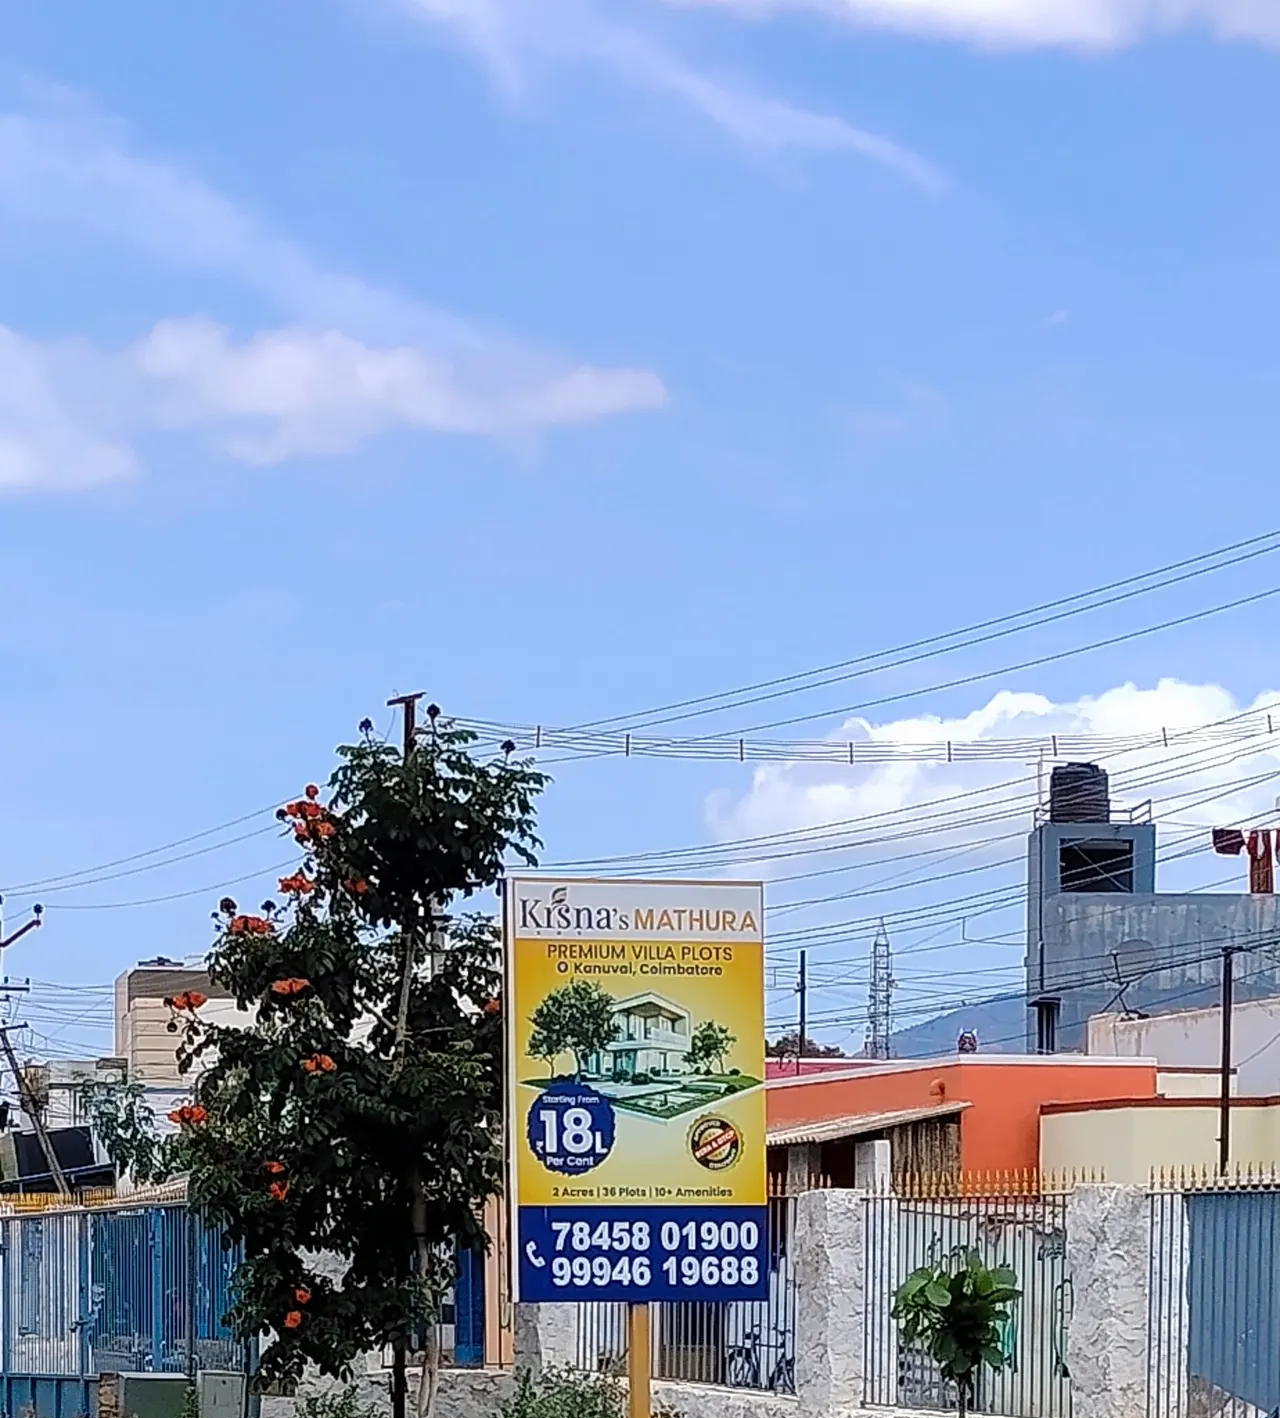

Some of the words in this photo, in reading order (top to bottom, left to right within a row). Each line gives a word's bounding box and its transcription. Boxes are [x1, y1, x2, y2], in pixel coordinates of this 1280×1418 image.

[634, 908, 758, 932] MATHURA
[547, 944, 626, 959] PREMIUM
[631, 945, 676, 960] VILLA
[681, 946, 732, 961] PLOTS
[639, 963, 723, 976] Coimbatore
[542, 1095, 576, 1106] Starting
[578, 1095, 600, 1104] From
[546, 1156, 564, 1166] Per
[566, 1156, 595, 1167] Cent
[552, 1187, 560, 1197] 2
[561, 1186, 595, 1198] Acres
[602, 1186, 617, 1198] 36
[618, 1186, 647, 1198] Plots
[654, 1187, 673, 1198] 10+
[675, 1186, 733, 1198] Amenities
[551, 1221, 651, 1251] 78458
[660, 1221, 759, 1251] 01900
[552, 1256, 652, 1286] 99946
[662, 1255, 760, 1286] 19688
